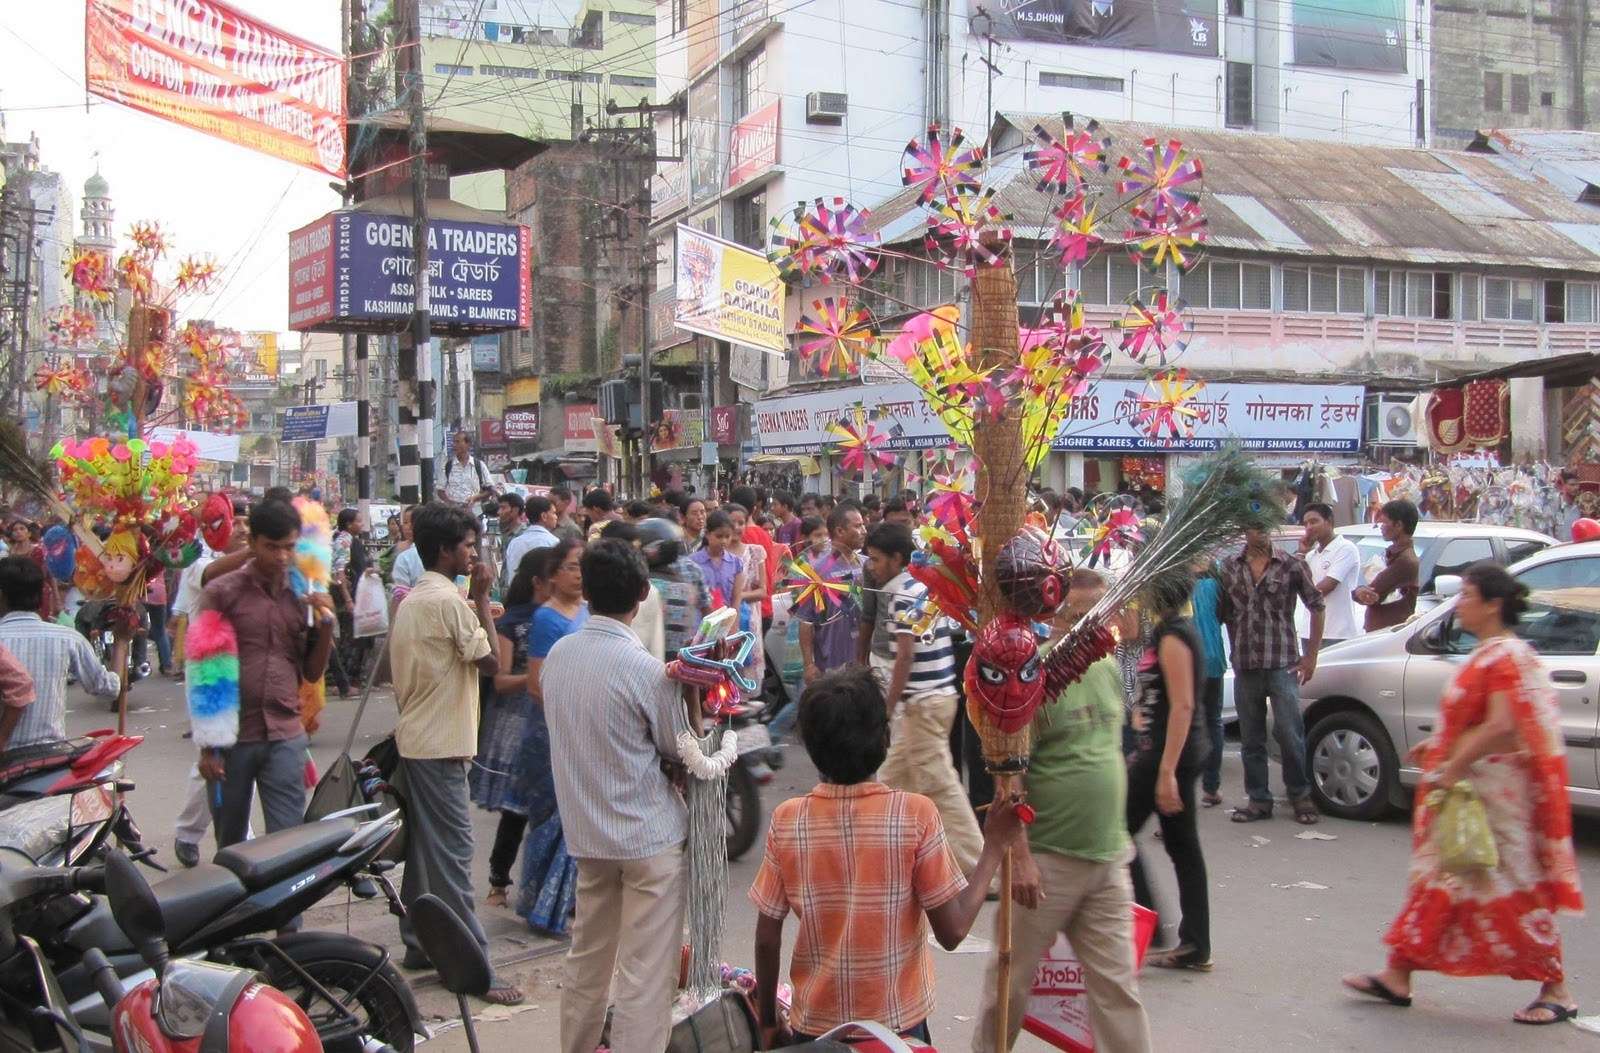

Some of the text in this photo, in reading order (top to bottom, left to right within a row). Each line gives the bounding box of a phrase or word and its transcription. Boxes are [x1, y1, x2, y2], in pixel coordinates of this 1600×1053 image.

[1017, 11, 1064, 24] M.S.DHONI
[366, 222, 517, 256] GOENA TRADERS
[340, 217, 350, 316] GOENKA TRADERS
[390, 283, 493, 302] ASSA ILK SAREES
[735, 279, 770, 300] GRAND
[365, 300, 517, 321] KASHIMAR HAWLS BLANKETS
[749, 317, 783, 338] STADIUM
[780, 408, 809, 432] TRADERS
[1246, 394, 1361, 429] गोयनका ट्रेडर्स
[1053, 438, 1095, 447] ESIGNER
[1097, 438, 1134, 449] SAREES,
[1267, 440, 1305, 449] SHAWLS,
[1308, 440, 1351, 449] BLANKETS
